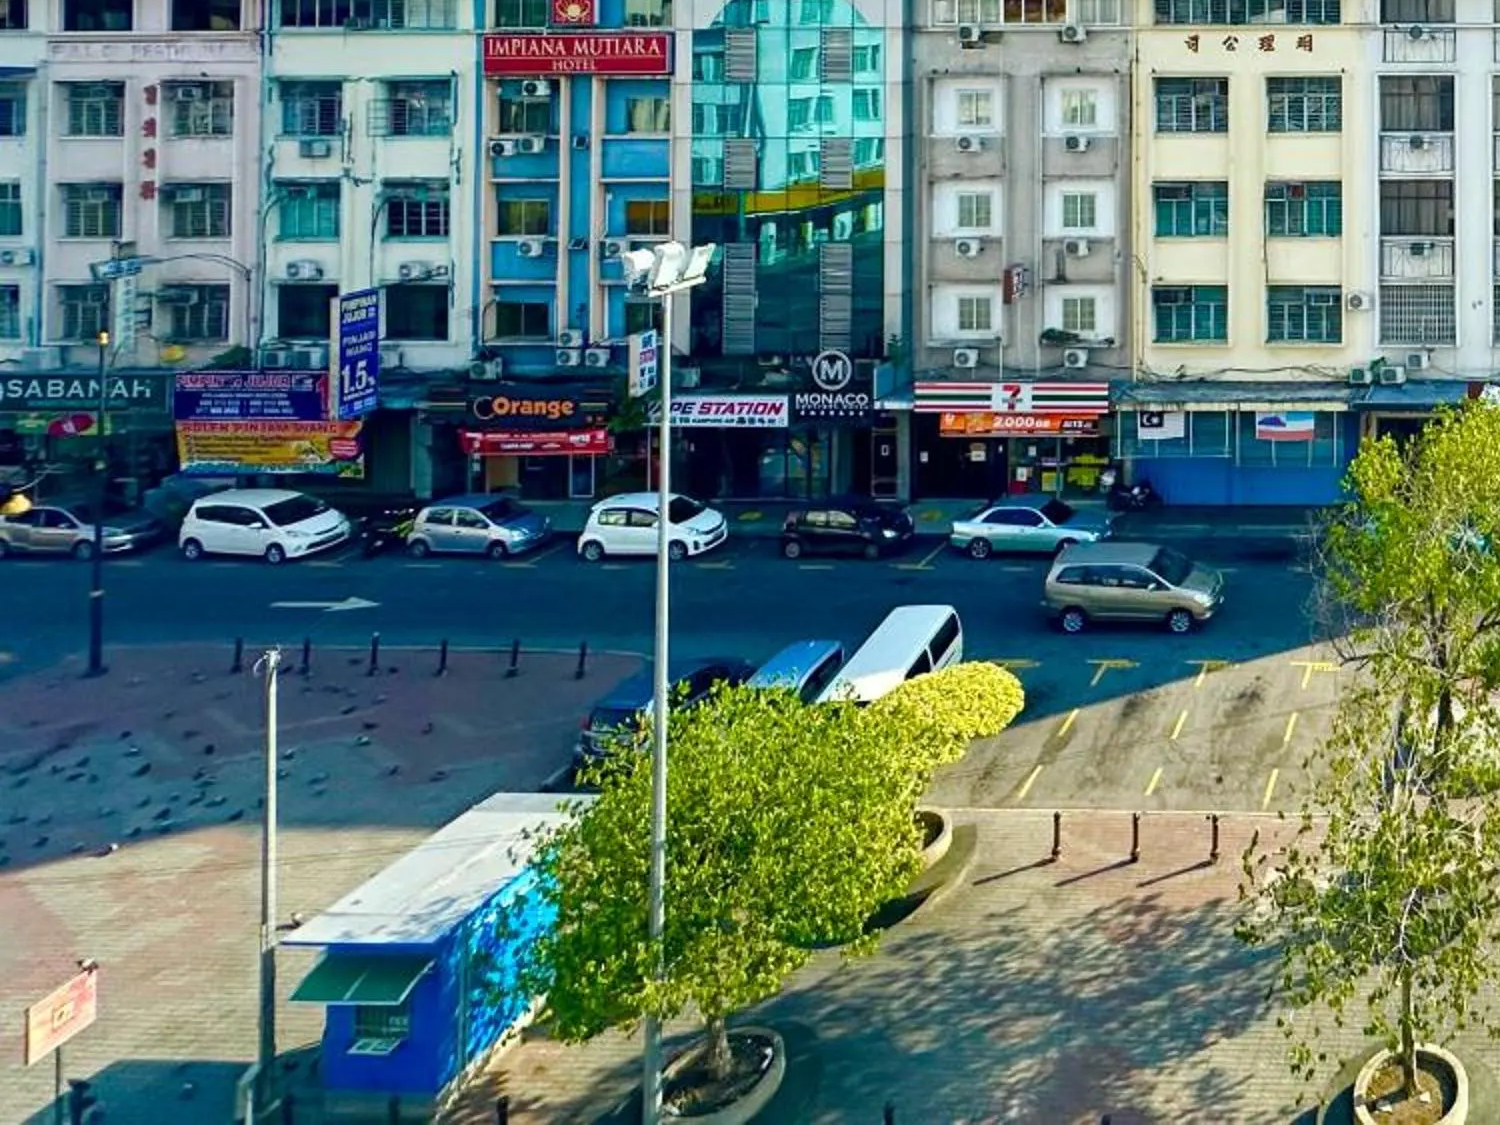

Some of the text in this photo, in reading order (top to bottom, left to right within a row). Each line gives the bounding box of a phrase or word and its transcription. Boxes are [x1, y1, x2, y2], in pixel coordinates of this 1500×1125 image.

[488, 38, 660, 56] IMPIANA MUTIARA
[552, 59, 597, 71] HOTEL
[820, 360, 843, 380] M
[795, 393, 869, 405] MONACO
[1002, 384, 1021, 410] 7
[492, 396, 575, 420] Orange
[698, 402, 784, 416] STATION
